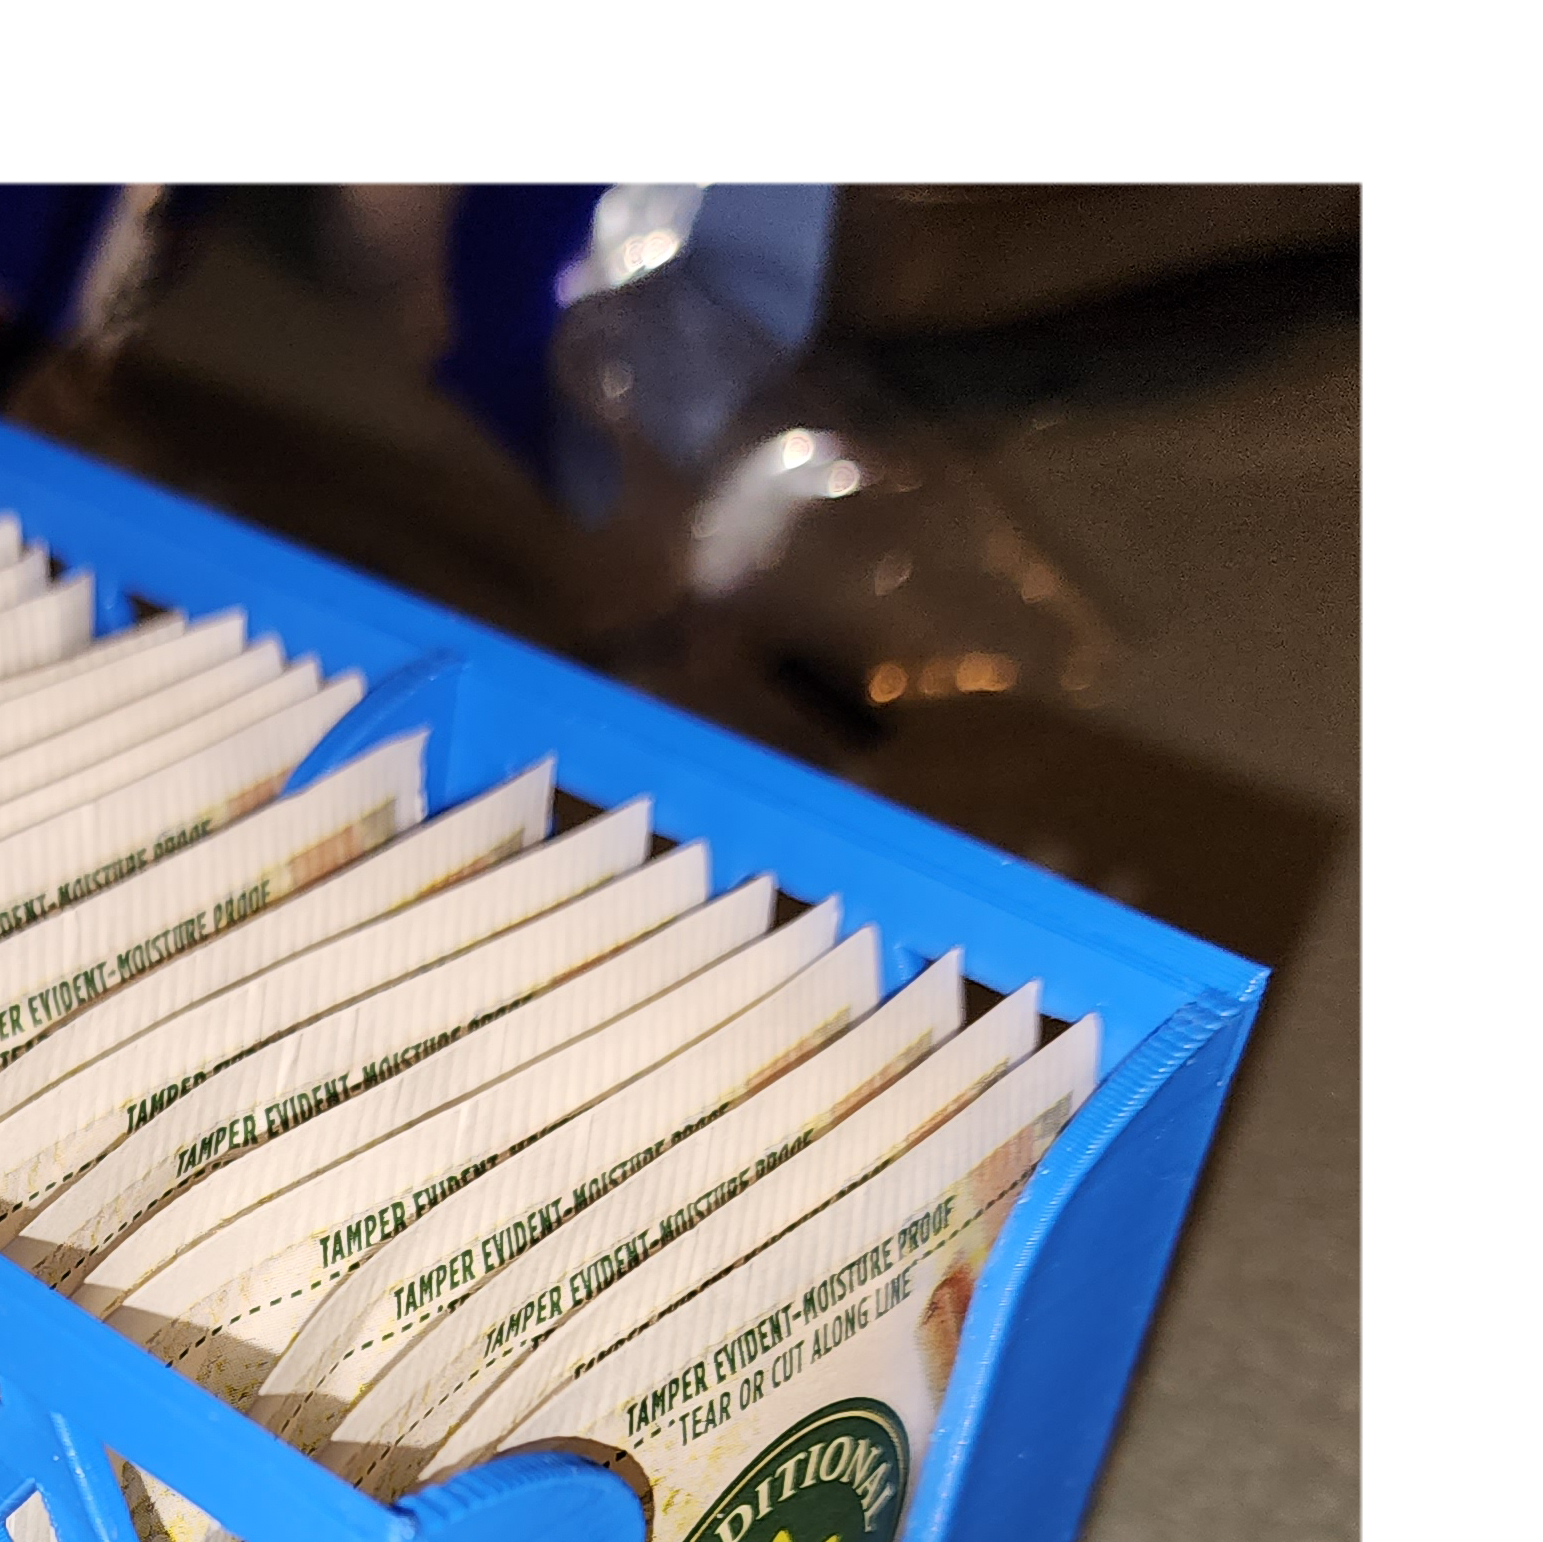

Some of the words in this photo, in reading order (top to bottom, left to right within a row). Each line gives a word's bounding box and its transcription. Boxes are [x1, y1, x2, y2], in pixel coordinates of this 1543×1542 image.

[27, 911, 207, 1028] EVIDENT-MOISTURE
[213, 880, 270, 931] PROOF
[176, 1114, 258, 1178] TAMPER
[319, 1201, 407, 1268] TAMPER
[393, 1249, 475, 1320] TAMPER
[626, 1361, 708, 1437] TAMPER
[714, 1236, 894, 1384] EVIDENT-MOISTURE
[898, 1195, 957, 1261] PROOF
[483, 1285, 563, 1358] TAMPER
[679, 1391, 731, 1446] TEAR
[740, 1369, 764, 1411] OR
[772, 1340, 805, 1389] CUT
[810, 1295, 871, 1365] ALONG
[875, 1267, 913, 1320] LINE
